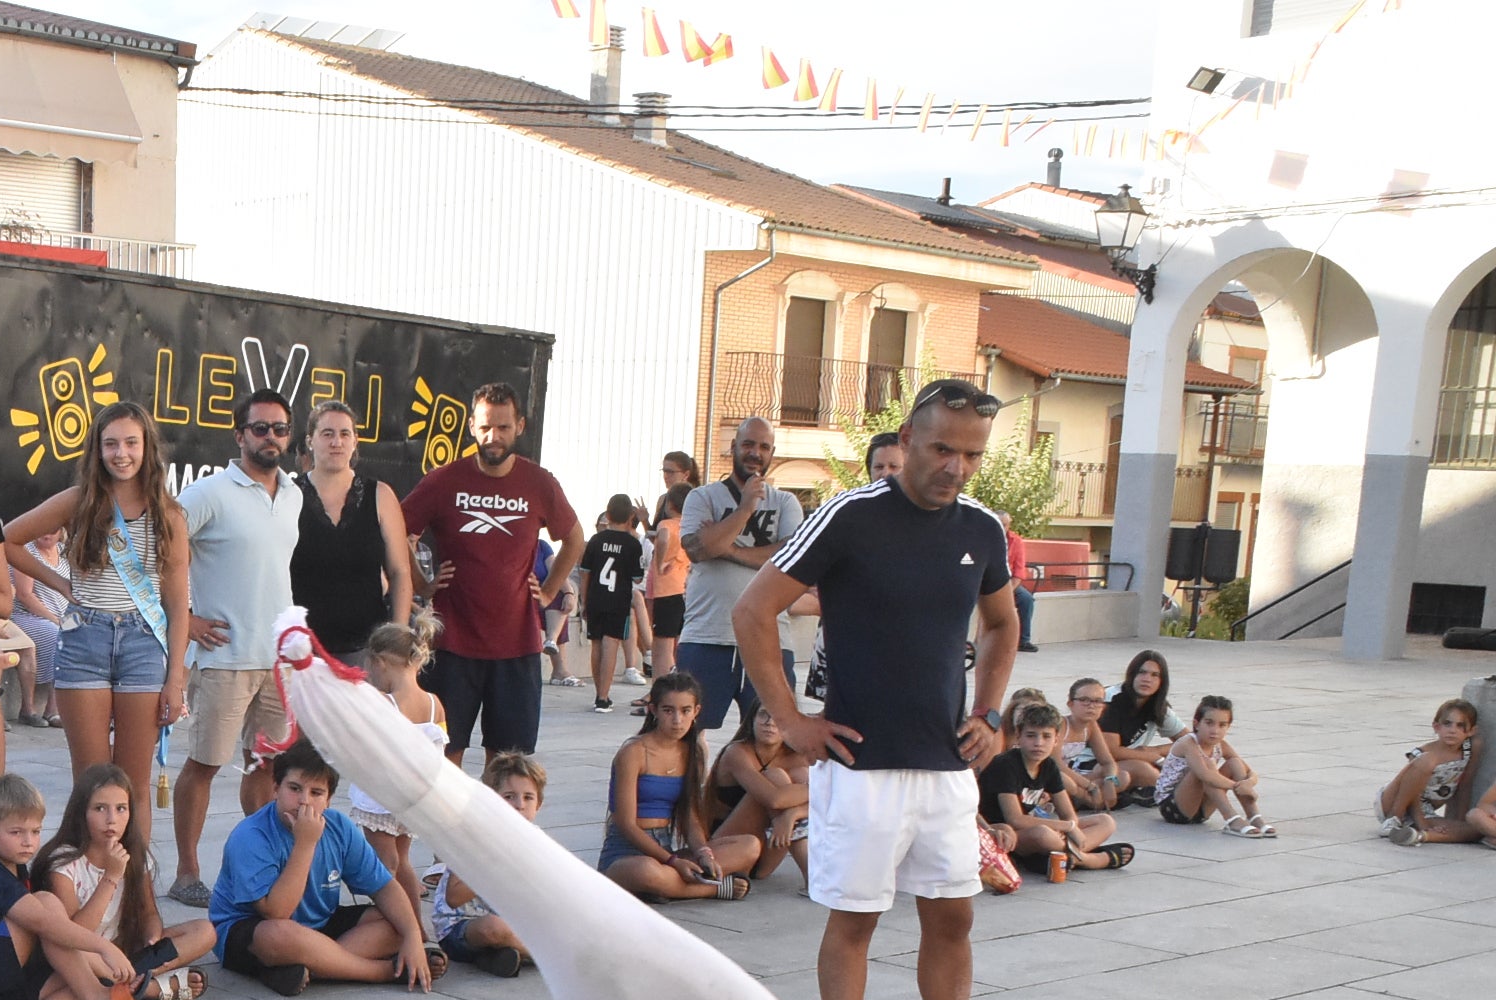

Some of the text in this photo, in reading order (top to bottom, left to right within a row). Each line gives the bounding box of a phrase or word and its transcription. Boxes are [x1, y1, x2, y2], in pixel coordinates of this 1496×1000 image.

[455, 492, 529, 513] Reebok
[602, 542, 623, 554] DANI
[598, 556, 617, 593] 4
